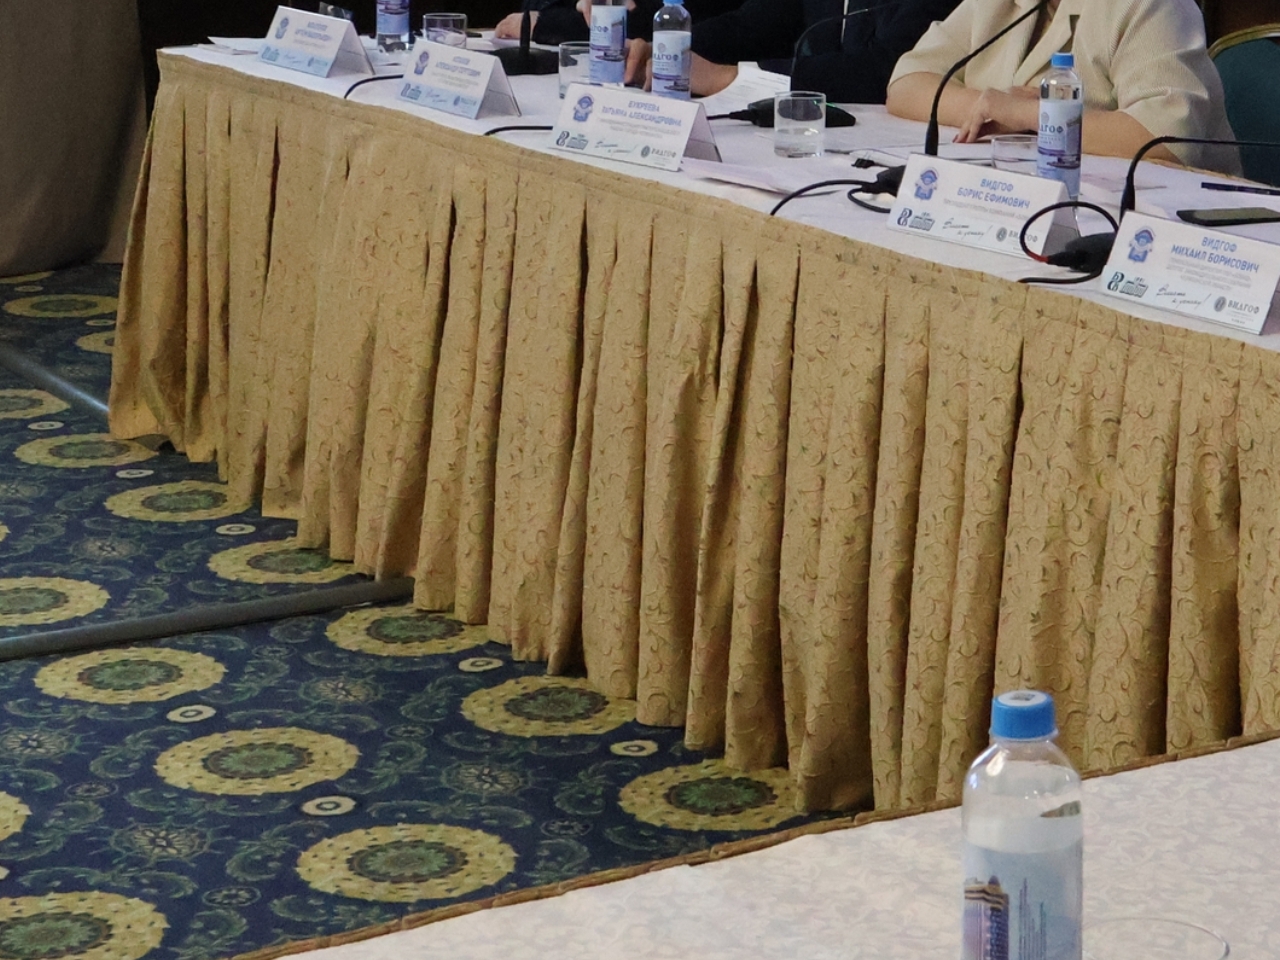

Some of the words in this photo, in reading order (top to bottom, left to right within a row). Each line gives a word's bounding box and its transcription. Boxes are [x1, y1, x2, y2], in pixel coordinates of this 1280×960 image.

[980, 178, 1013, 193] ВИДГОФ
[957, 187, 983, 200] БОРИС
[984, 192, 1030, 208] ЕФИМОВИЧ
[1009, 230, 1038, 242] ВИГОФ
[1201, 236, 1237, 252] ВИДГОФ
[1171, 244, 1206, 260] МИХАИЛ
[1208, 252, 1260, 273] БОРИСОВИЧ
[1228, 299, 1260, 314] ВИДГОФ
